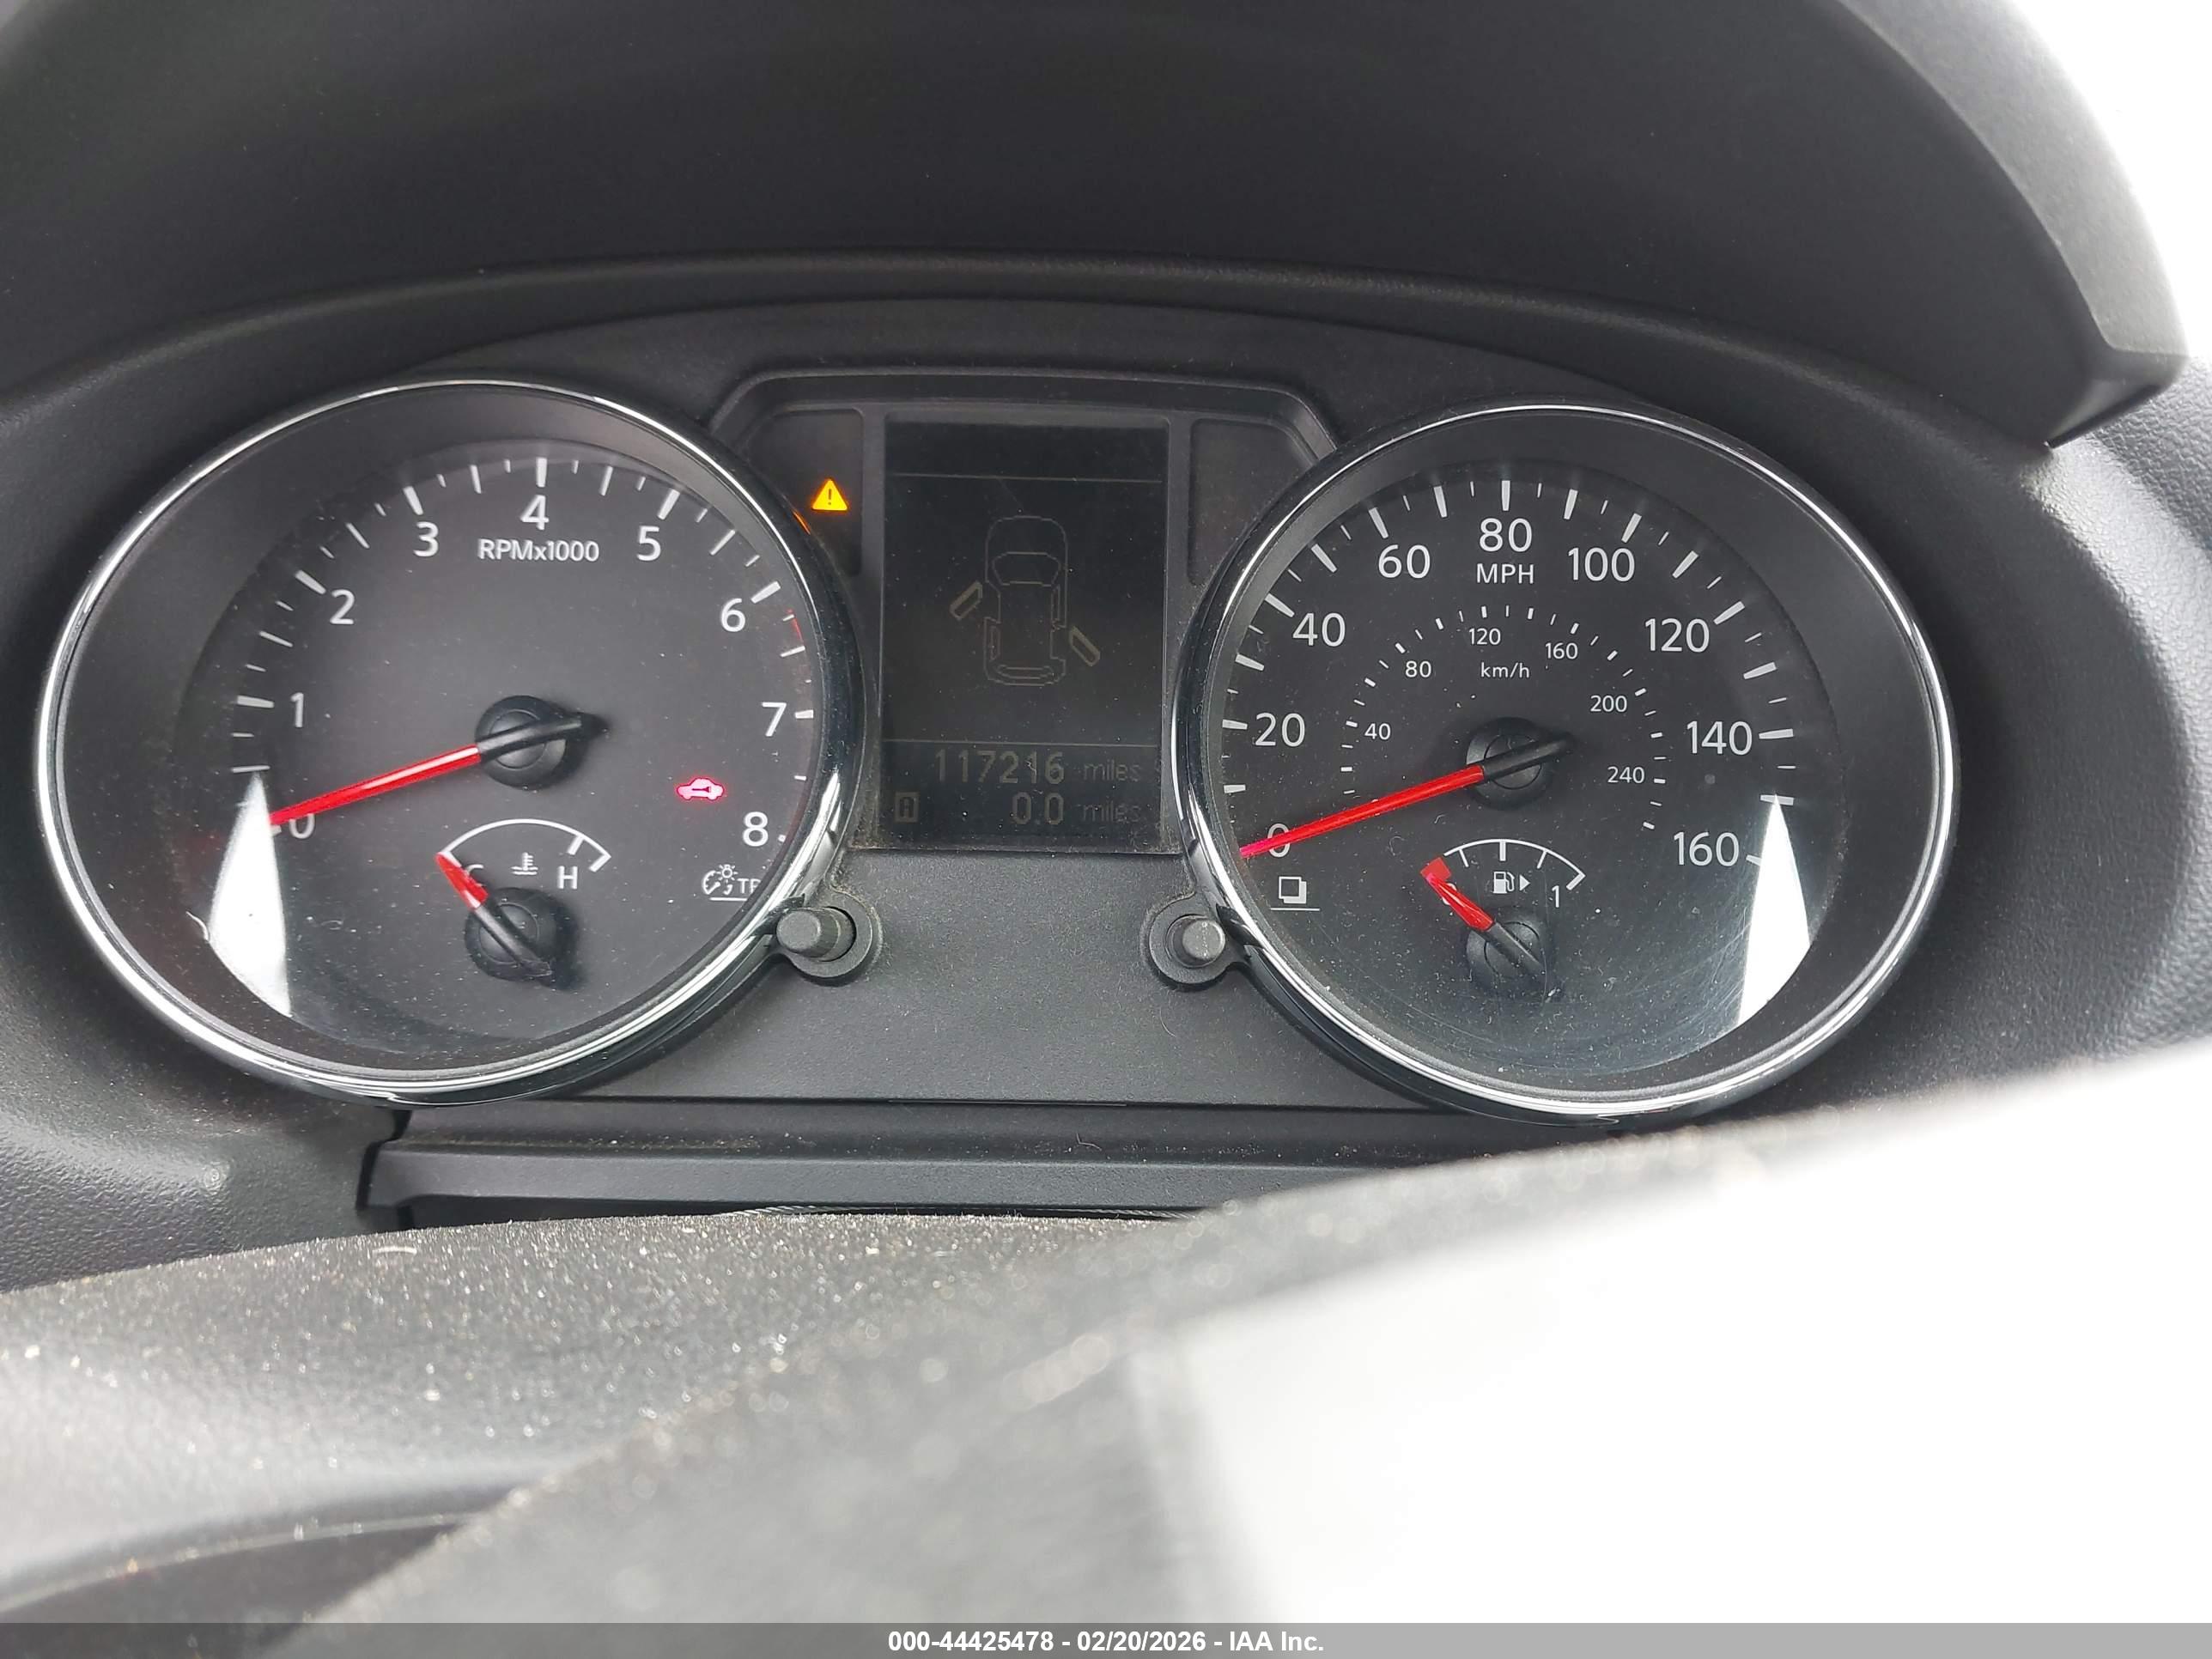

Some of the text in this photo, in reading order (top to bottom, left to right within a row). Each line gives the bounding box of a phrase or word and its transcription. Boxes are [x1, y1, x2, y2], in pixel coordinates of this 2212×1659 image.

[520, 495, 550, 531] 4
[415, 521, 439, 557] 3
[477, 538, 600, 562] RPMx1000
[637, 526, 661, 562] 5
[1480, 518, 1533, 552] 80
[1378, 544, 1431, 579] 60
[1476, 563, 1534, 584] MPH
[1567, 547, 1635, 582] 100
[331, 589, 355, 625] 2
[720, 598, 746, 632] 6
[1292, 612, 1346, 647] 40
[1468, 628, 1502, 646] 120
[1645, 617, 1710, 653] 120
[1545, 642, 1579, 660] 160
[1405, 660, 1431, 678] 80
[1480, 662, 1530, 680] km/h
[291, 692, 304, 728] 1
[762, 702, 787, 737] 7
[1590, 695, 1627, 713] 200
[1255, 713, 1305, 747] 20
[1364, 723, 1391, 740] 40
[1686, 720, 1753, 756] 140
[935, 748, 1143, 785] 117216 miles
[1607, 766, 1645, 785] 240
[1083, 797, 1142, 823] miles
[742, 811, 769, 848] 8
[1267, 823, 1291, 858] 0
[1673, 831, 1740, 866] 160
[558, 866, 578, 890] H
[1551, 885, 1560, 908] 1
